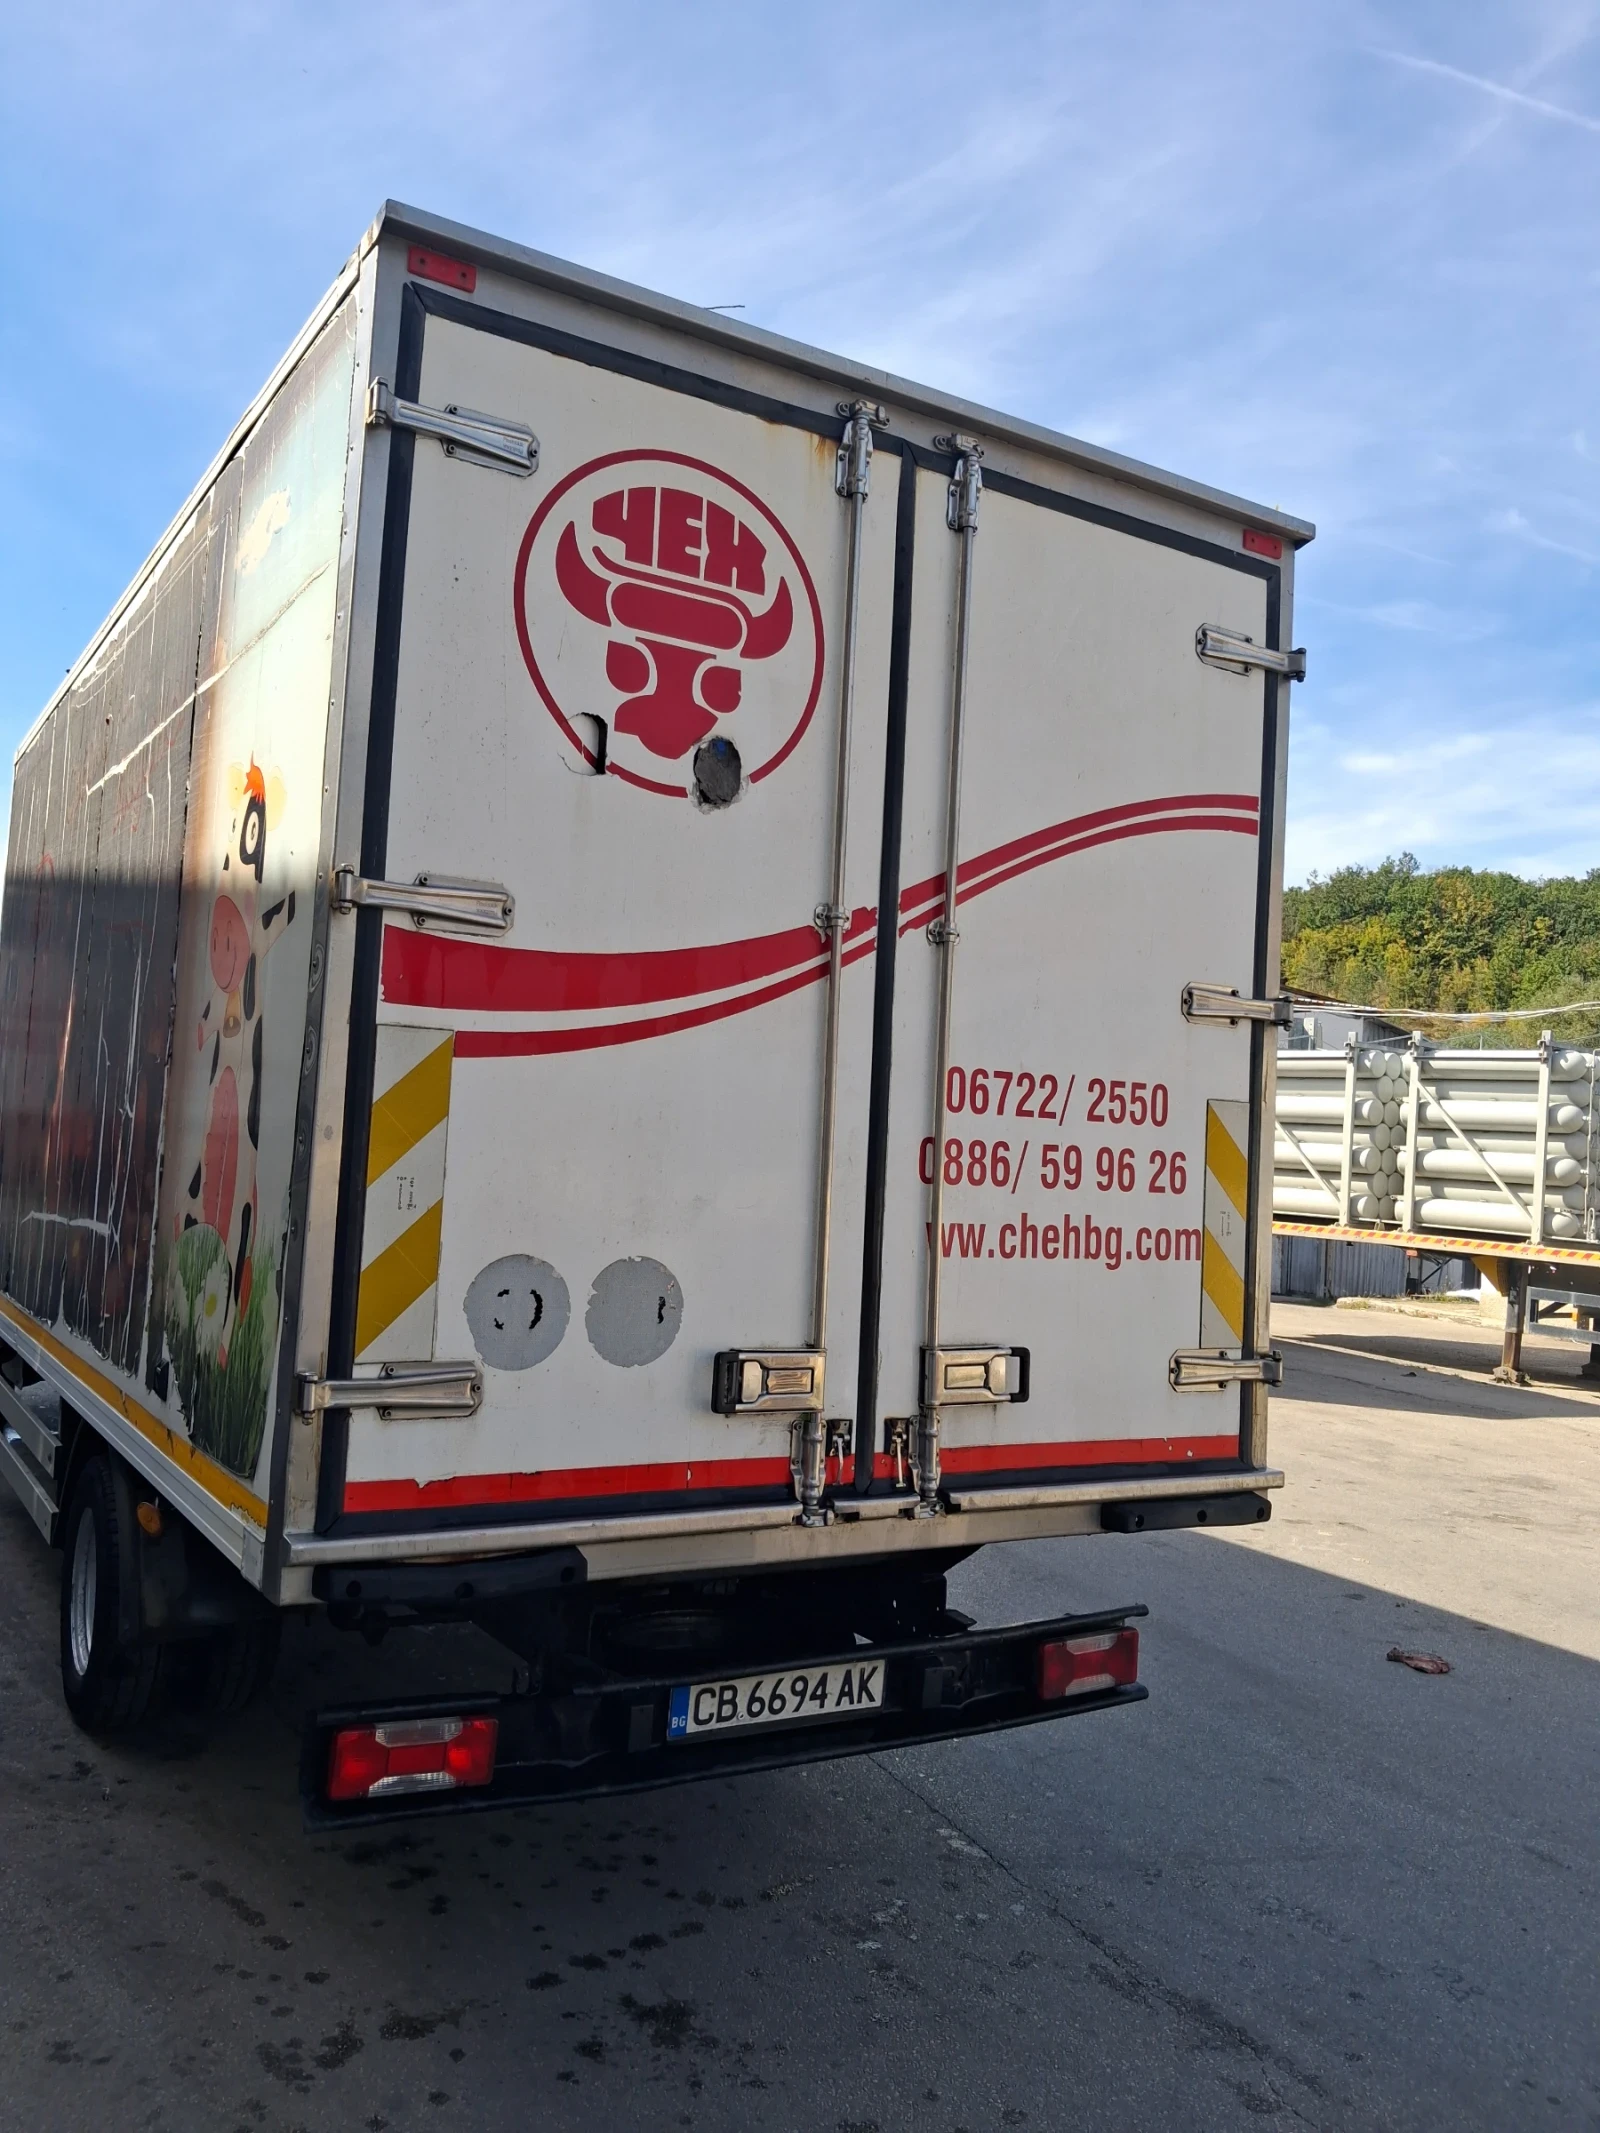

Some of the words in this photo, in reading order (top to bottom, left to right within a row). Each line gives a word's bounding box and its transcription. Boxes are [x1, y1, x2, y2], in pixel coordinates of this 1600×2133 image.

[592, 486, 767, 597] ЧЕХ
[945, 1065, 1075, 1123] 06722/
[1086, 1077, 1169, 1128] 2550
[917, 1137, 1029, 1193] 0886/
[1040, 1143, 1083, 1191] 59
[1095, 1146, 1136, 1193] 96
[1148, 1149, 1188, 1195] 26
[671, 1715, 686, 1729] BG
